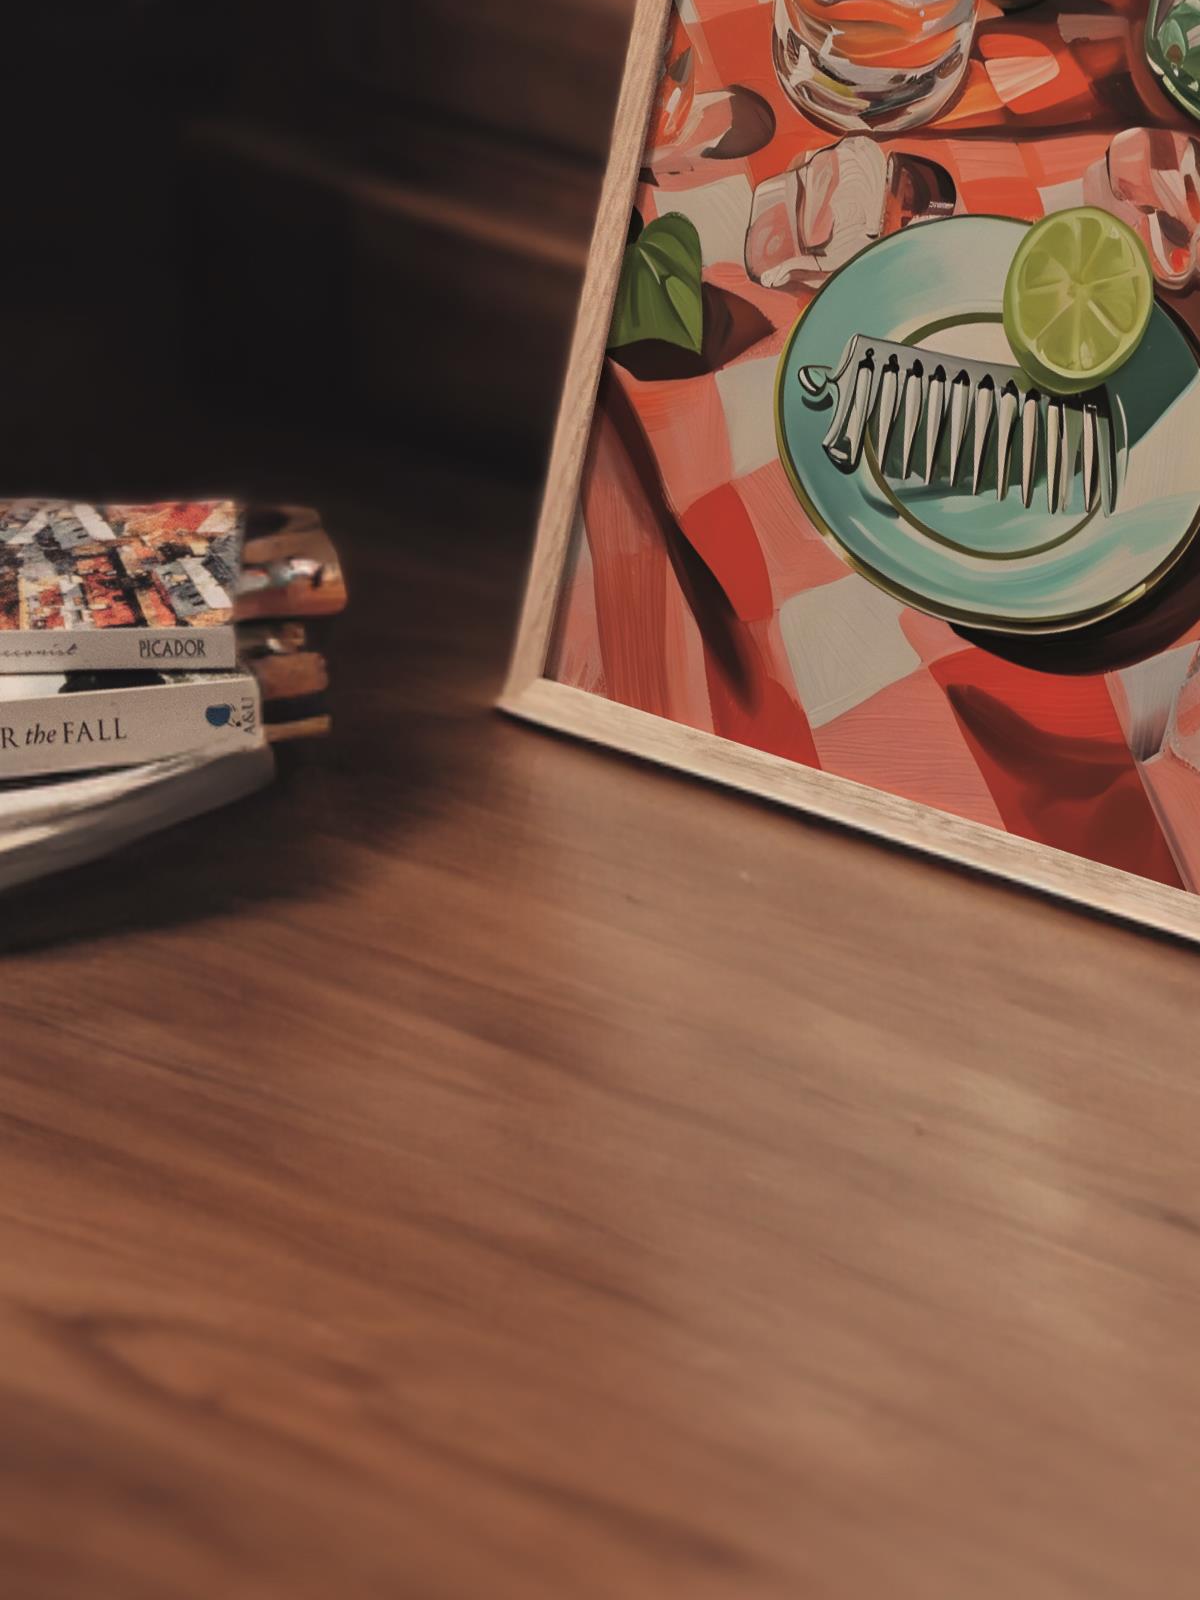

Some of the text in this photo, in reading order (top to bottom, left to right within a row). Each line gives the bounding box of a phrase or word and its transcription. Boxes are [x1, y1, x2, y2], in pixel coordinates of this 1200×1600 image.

[138, 639, 206, 658] PICADOR
[25, 723, 57, 746] the
[63, 717, 128, 744] FALL
